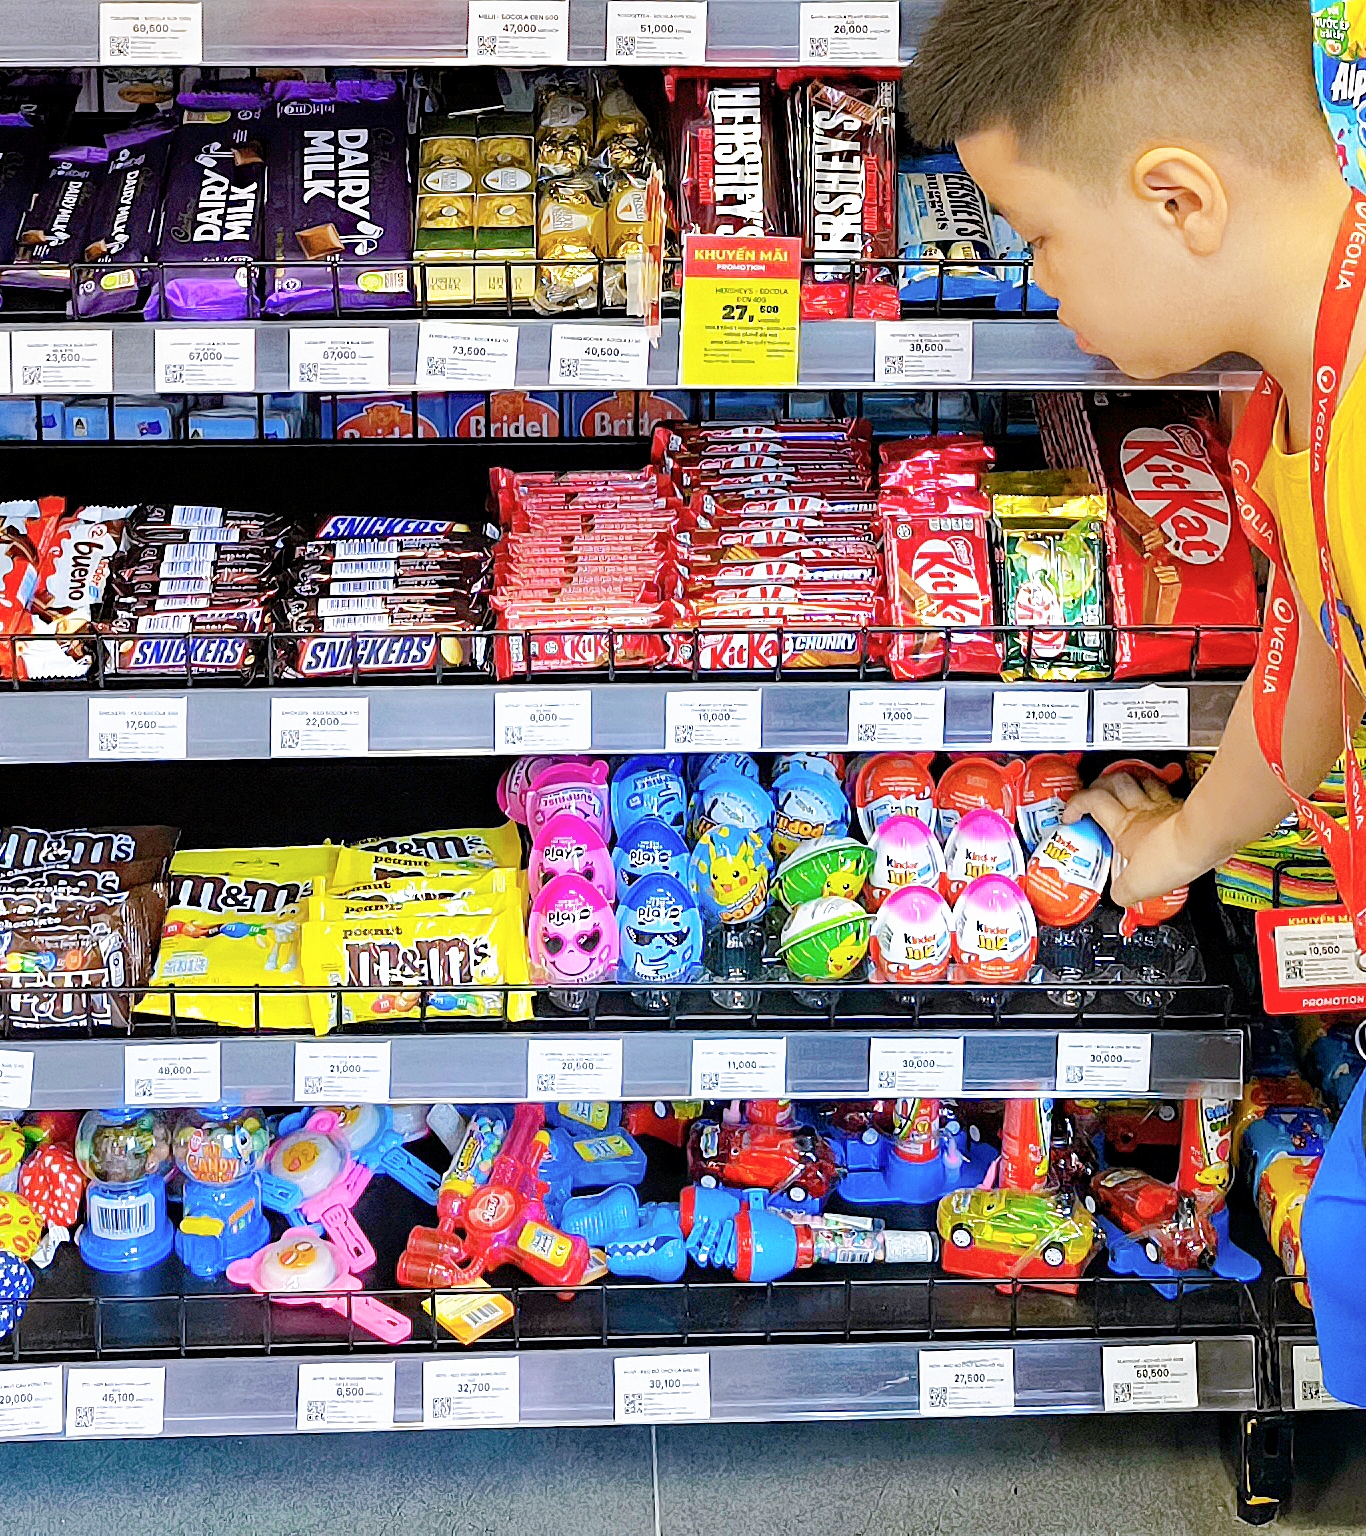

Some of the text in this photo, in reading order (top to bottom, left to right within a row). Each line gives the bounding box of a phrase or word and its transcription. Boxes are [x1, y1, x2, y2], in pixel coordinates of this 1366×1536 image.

[502, 23, 537, 34] 47,000
[303, 128, 370, 233] DAIRY MILK
[193, 170, 258, 243] DAIRY MILK
[695, 246, 790, 264] KHUYẾN MÃI
[1336, 221, 1366, 291] VEOLIA
[470, 409, 551, 440] Bridel
[1313, 396, 1334, 474] VEOLIA
[1122, 426, 1230, 565] KitKat
[67, 541, 96, 603] bueno
[792, 632, 857, 652] CHUNKY
[134, 638, 244, 668] SNICKERS
[304, 638, 434, 673] SNICKERS
[1262, 623, 1287, 696] VEOLIA
[304, 717, 339, 727] 22,000
[882, 711, 913, 721] 17,000
[886, 856, 918, 870] kinder
[342, 924, 404, 940] peanut
[976, 921, 1010, 935] kinder
[904, 933, 936, 944] kinder
[344, 934, 493, 987] m&m's
[1302, 994, 1366, 1009] PROMOTION
[329, 1064, 361, 1074] 21,000
[727, 1059, 758, 1069] 11,000
[902, 1059, 935, 1069] 30,000
[457, 1382, 491, 1393] 32,700
[0, 1393, 33, 1404] 20,000
